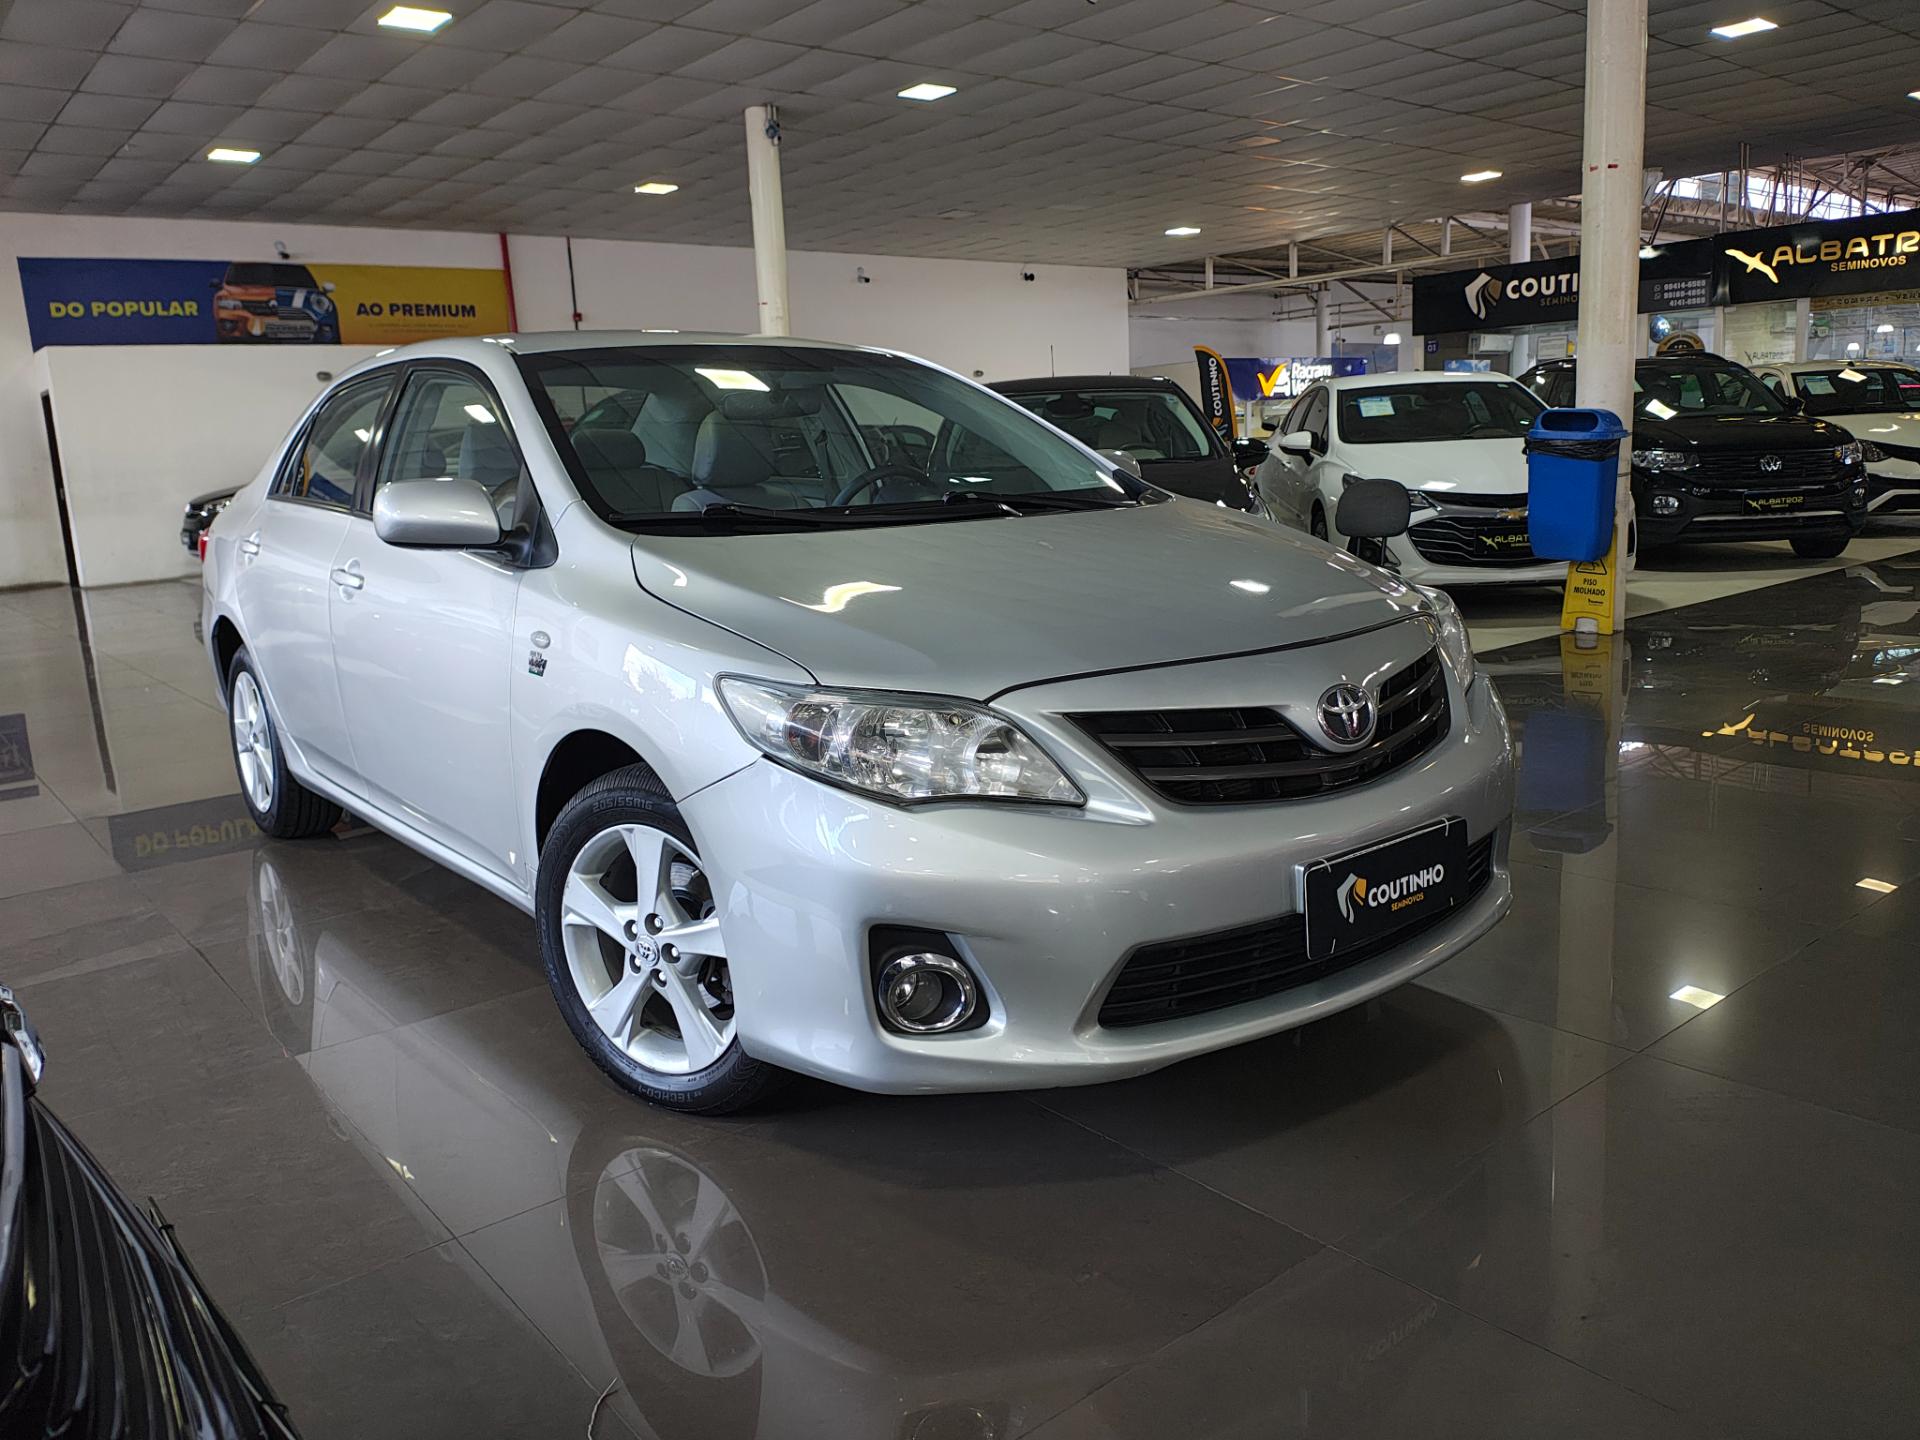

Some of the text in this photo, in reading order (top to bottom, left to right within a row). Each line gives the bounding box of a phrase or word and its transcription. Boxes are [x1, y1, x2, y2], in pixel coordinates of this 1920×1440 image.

[1830, 255, 1907, 272] SEMINOVOS
[1506, 273, 1578, 299] COUTI
[49, 300, 198, 318] DO POPULAR
[357, 303, 476, 317] AO PREMIUM
[1208, 357, 1223, 416] COUTINHO
[1583, 578, 1597, 586] PISO
[1573, 586, 1605, 597] MOLHADO
[1368, 864, 1445, 907] COUTINHO
[1391, 892, 1425, 912] SEMINOVOS
